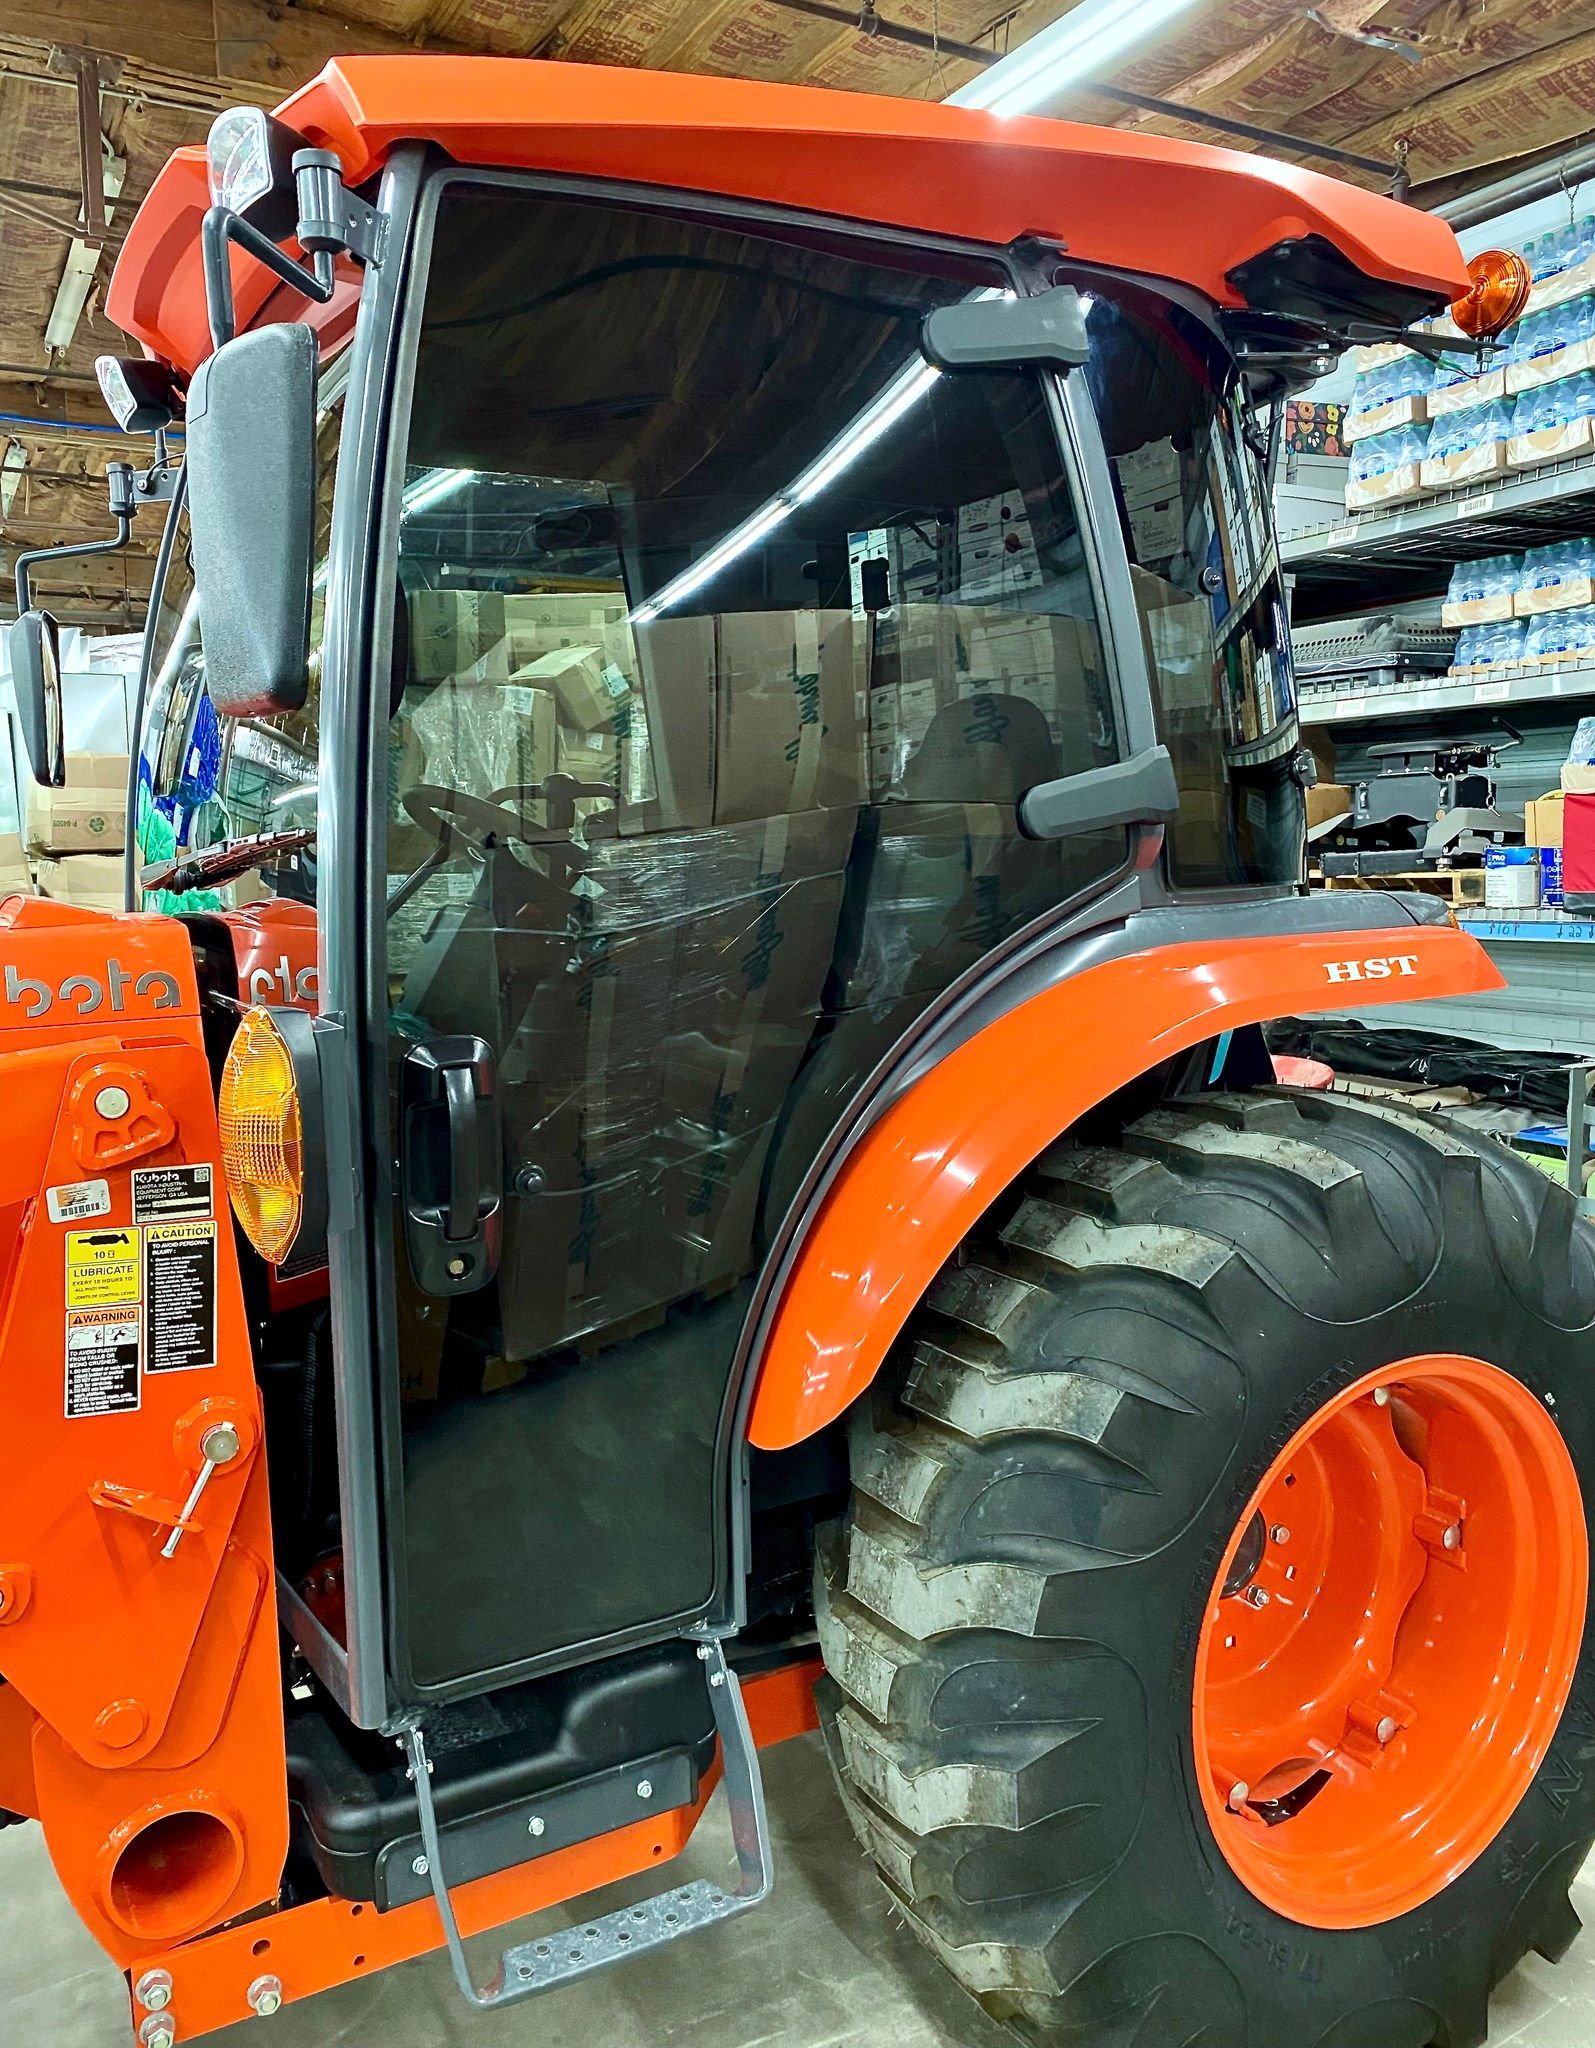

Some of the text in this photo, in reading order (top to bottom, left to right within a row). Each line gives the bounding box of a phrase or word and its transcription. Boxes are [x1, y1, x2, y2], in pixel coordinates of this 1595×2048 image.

[1322, 954, 1419, 984] HST
[4, 958, 183, 1018] bota
[135, 1171, 180, 1183] Kubota
[162, 1227, 211, 1238] CAUTION
[94, 1251, 105, 1259] 10
[74, 1265, 134, 1277] LUBRICATE
[83, 1311, 135, 1323] WARNING
